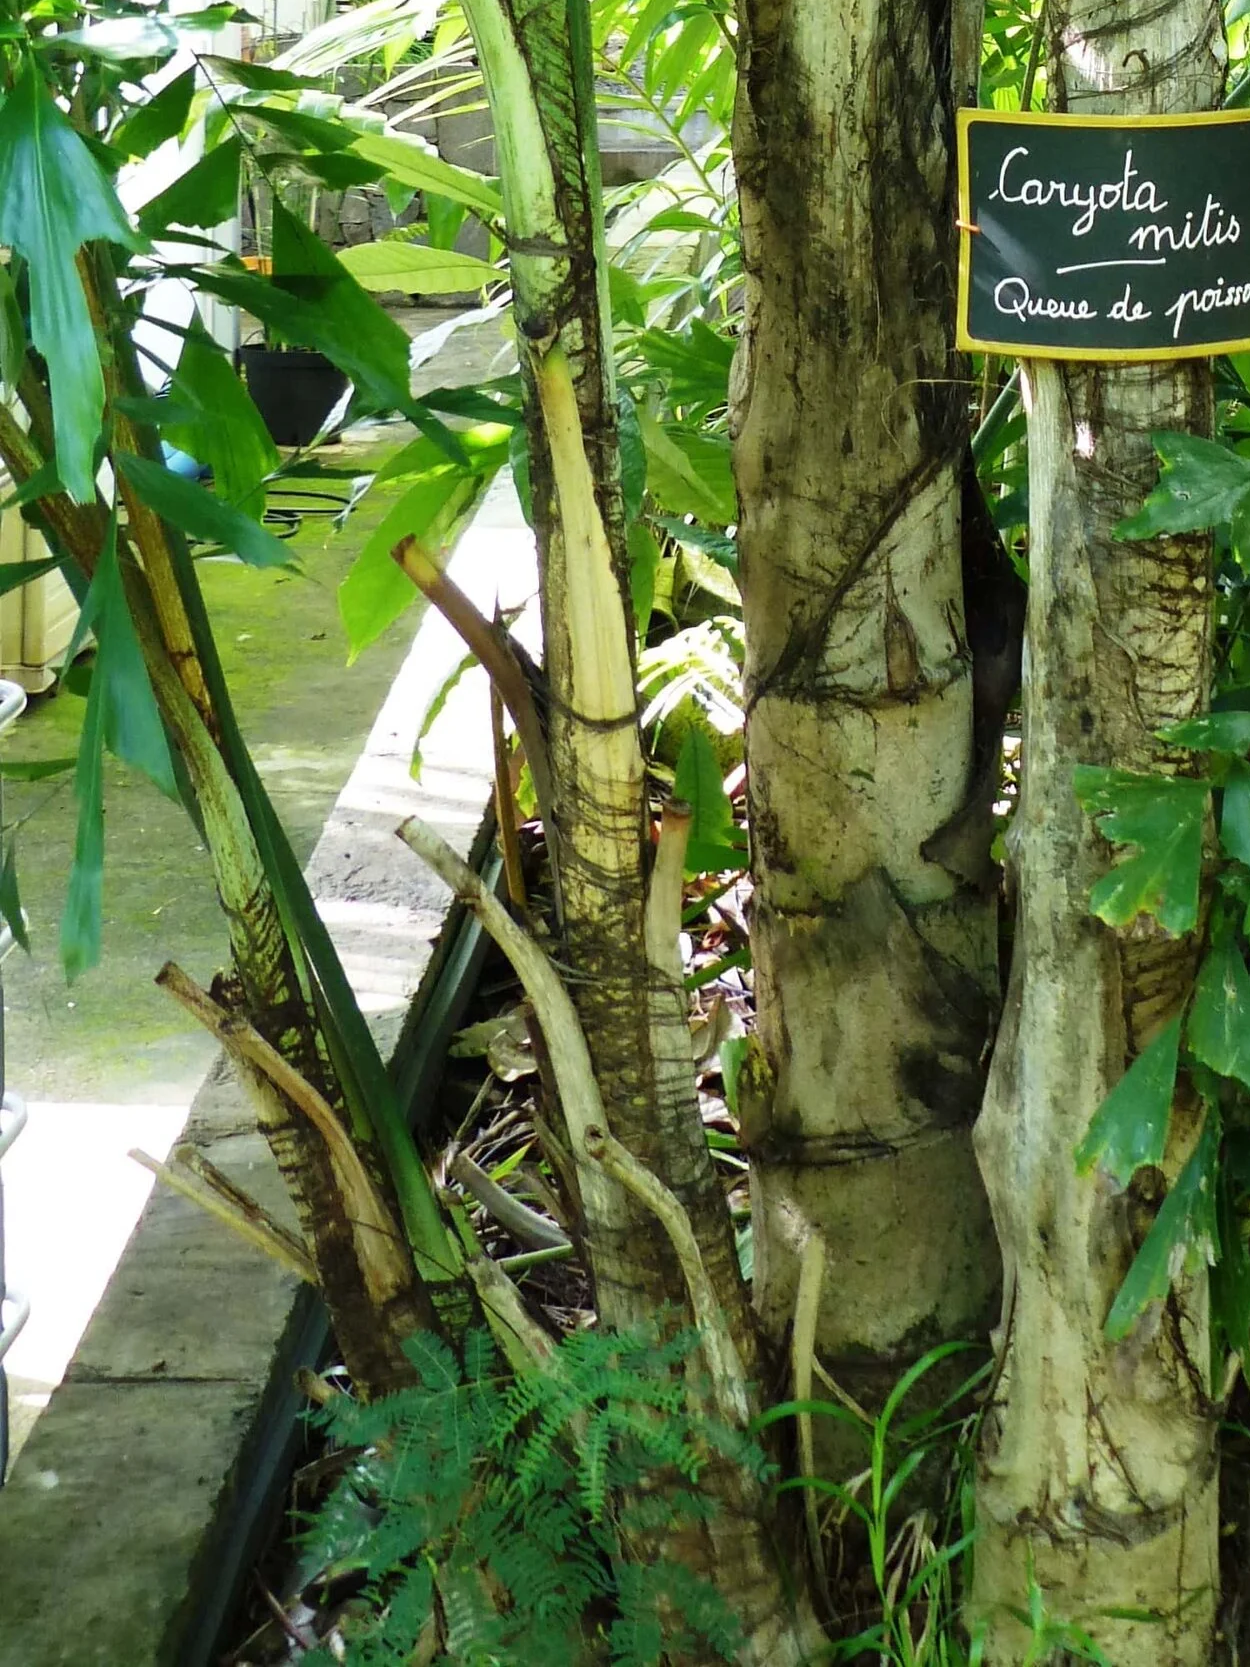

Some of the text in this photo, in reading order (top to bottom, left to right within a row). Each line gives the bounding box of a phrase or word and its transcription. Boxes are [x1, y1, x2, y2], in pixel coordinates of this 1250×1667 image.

[988, 146, 1168, 236] Caryota
[1128, 193, 1240, 250] mitis
[994, 277, 1098, 323] Queue
[1106, 283, 1152, 322] de
